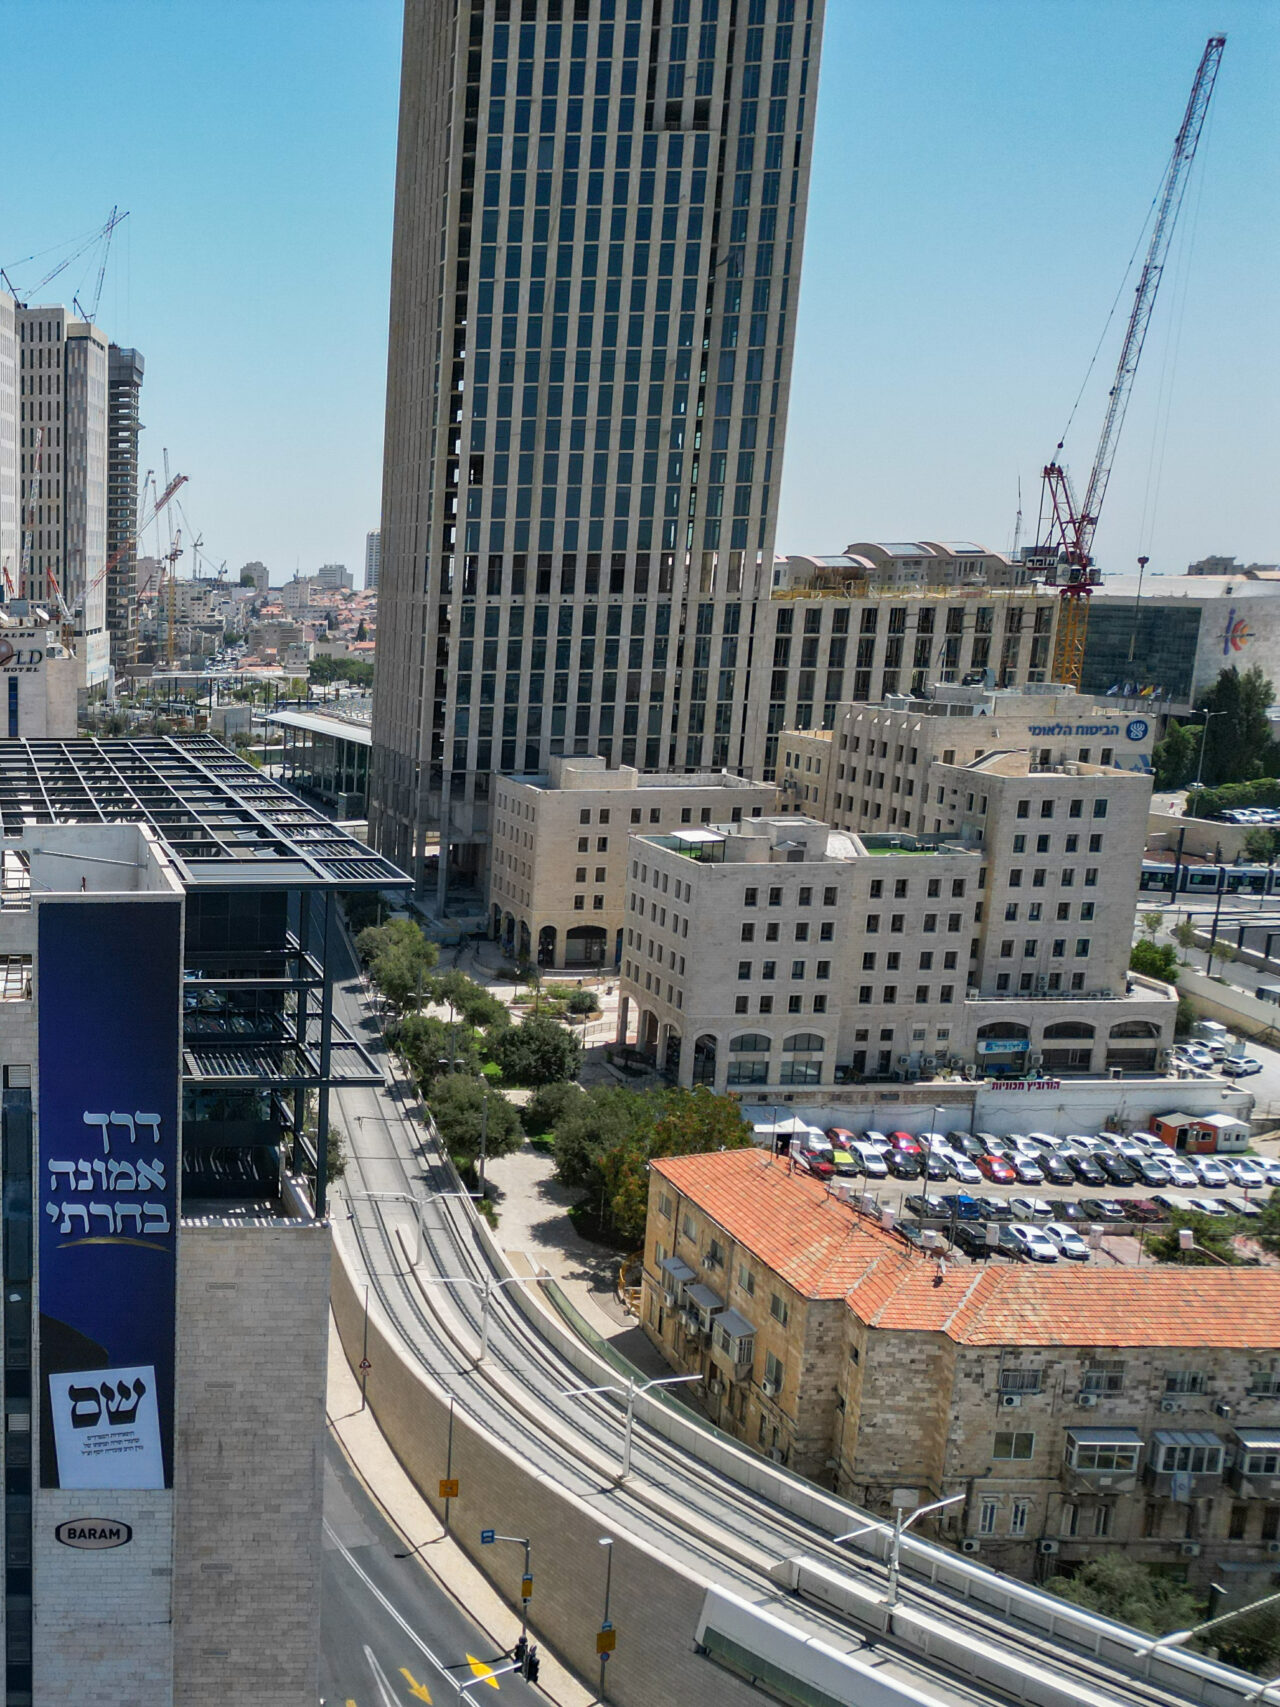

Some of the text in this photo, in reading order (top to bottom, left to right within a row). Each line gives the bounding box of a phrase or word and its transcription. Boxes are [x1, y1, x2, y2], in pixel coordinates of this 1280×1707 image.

[1028, 723, 1119, 736] הביטוח הלאומי
[83, 1110, 161, 1154] דרך
[48, 1158, 167, 1191] אמונה
[45, 1201, 171, 1233] בחרתי
[67, 1528, 121, 1540] BARAM
